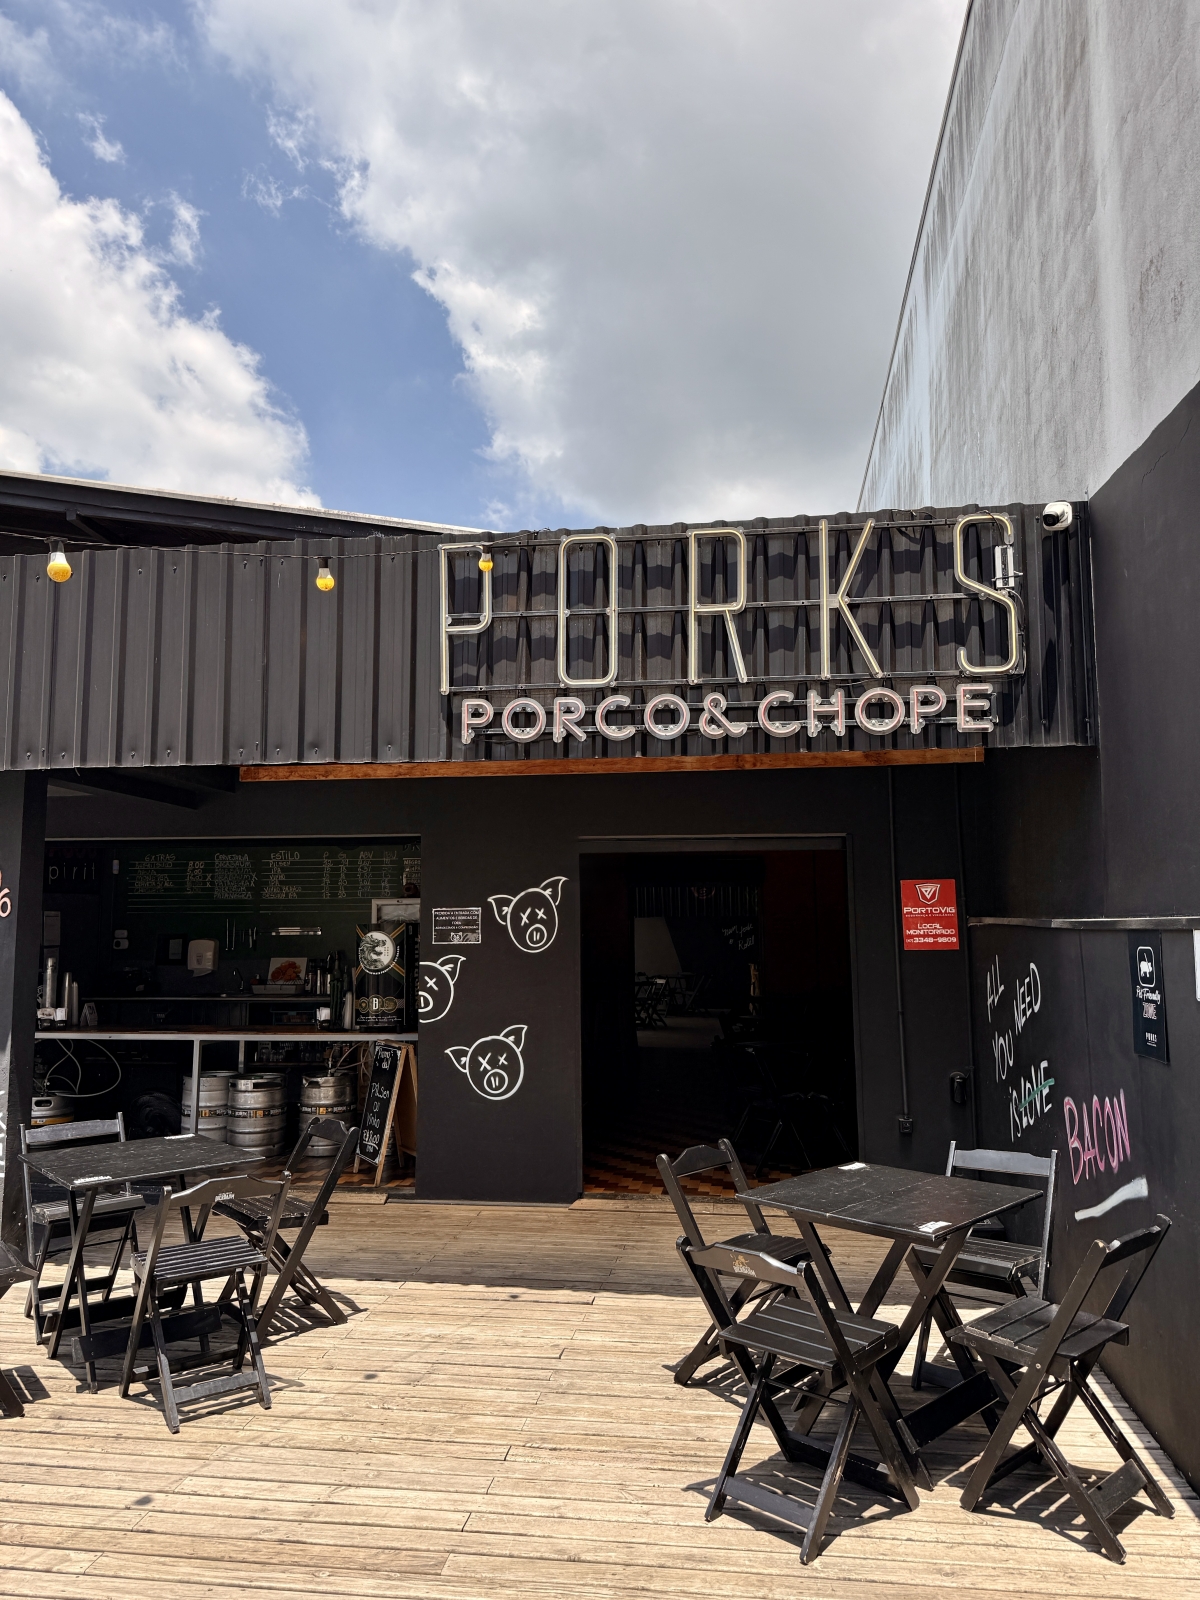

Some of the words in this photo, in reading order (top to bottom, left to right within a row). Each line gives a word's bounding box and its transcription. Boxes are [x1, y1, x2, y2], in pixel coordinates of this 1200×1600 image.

[439, 513, 1021, 695] PORKS
[903, 906, 956, 914] PORTOVIG
[986, 955, 1004, 1023] ALL
[992, 1029, 1014, 1083] YOU
[1014, 962, 1041, 1036] NEED
[1020, 1060, 1053, 1129] LOVE
[1064, 1088, 1131, 1185] BACON
